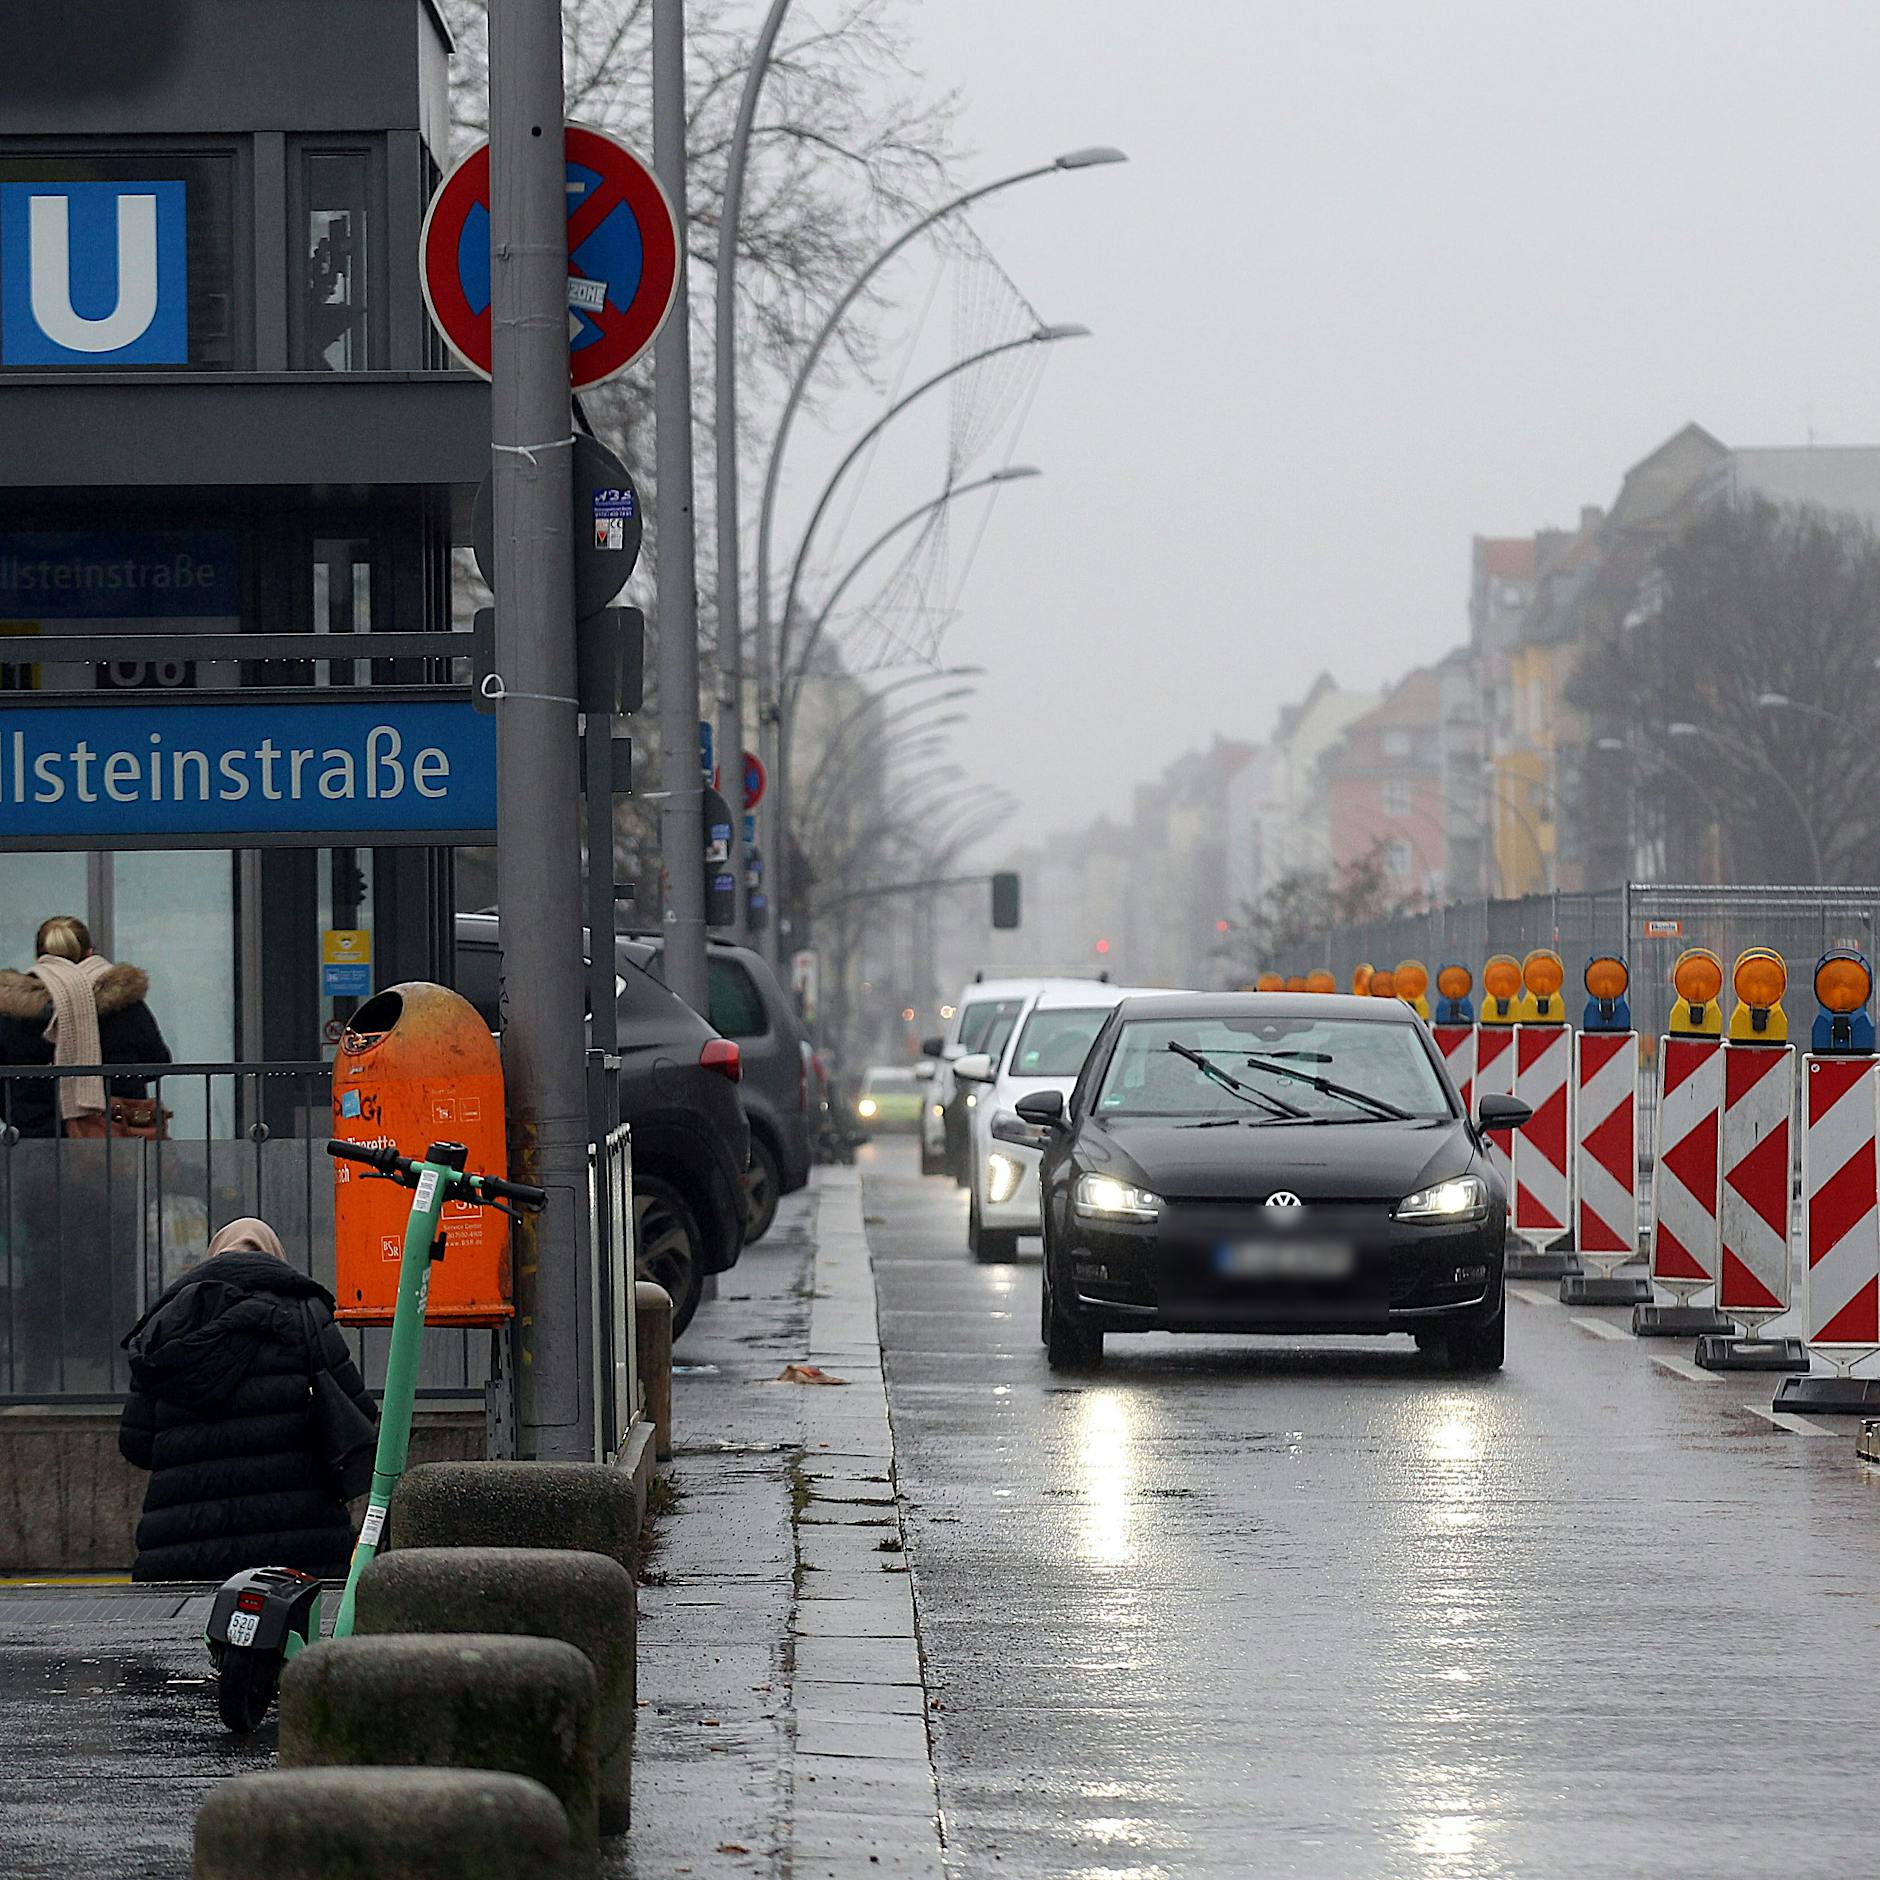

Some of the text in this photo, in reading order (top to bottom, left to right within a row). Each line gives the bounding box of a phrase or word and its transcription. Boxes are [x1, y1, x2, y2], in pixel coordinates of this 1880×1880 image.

[29, 194, 159, 353] U
[0, 725, 451, 804] lsteinstraße
[383, 1240, 399, 1257] BSR
[232, 1615, 256, 1631] 520
